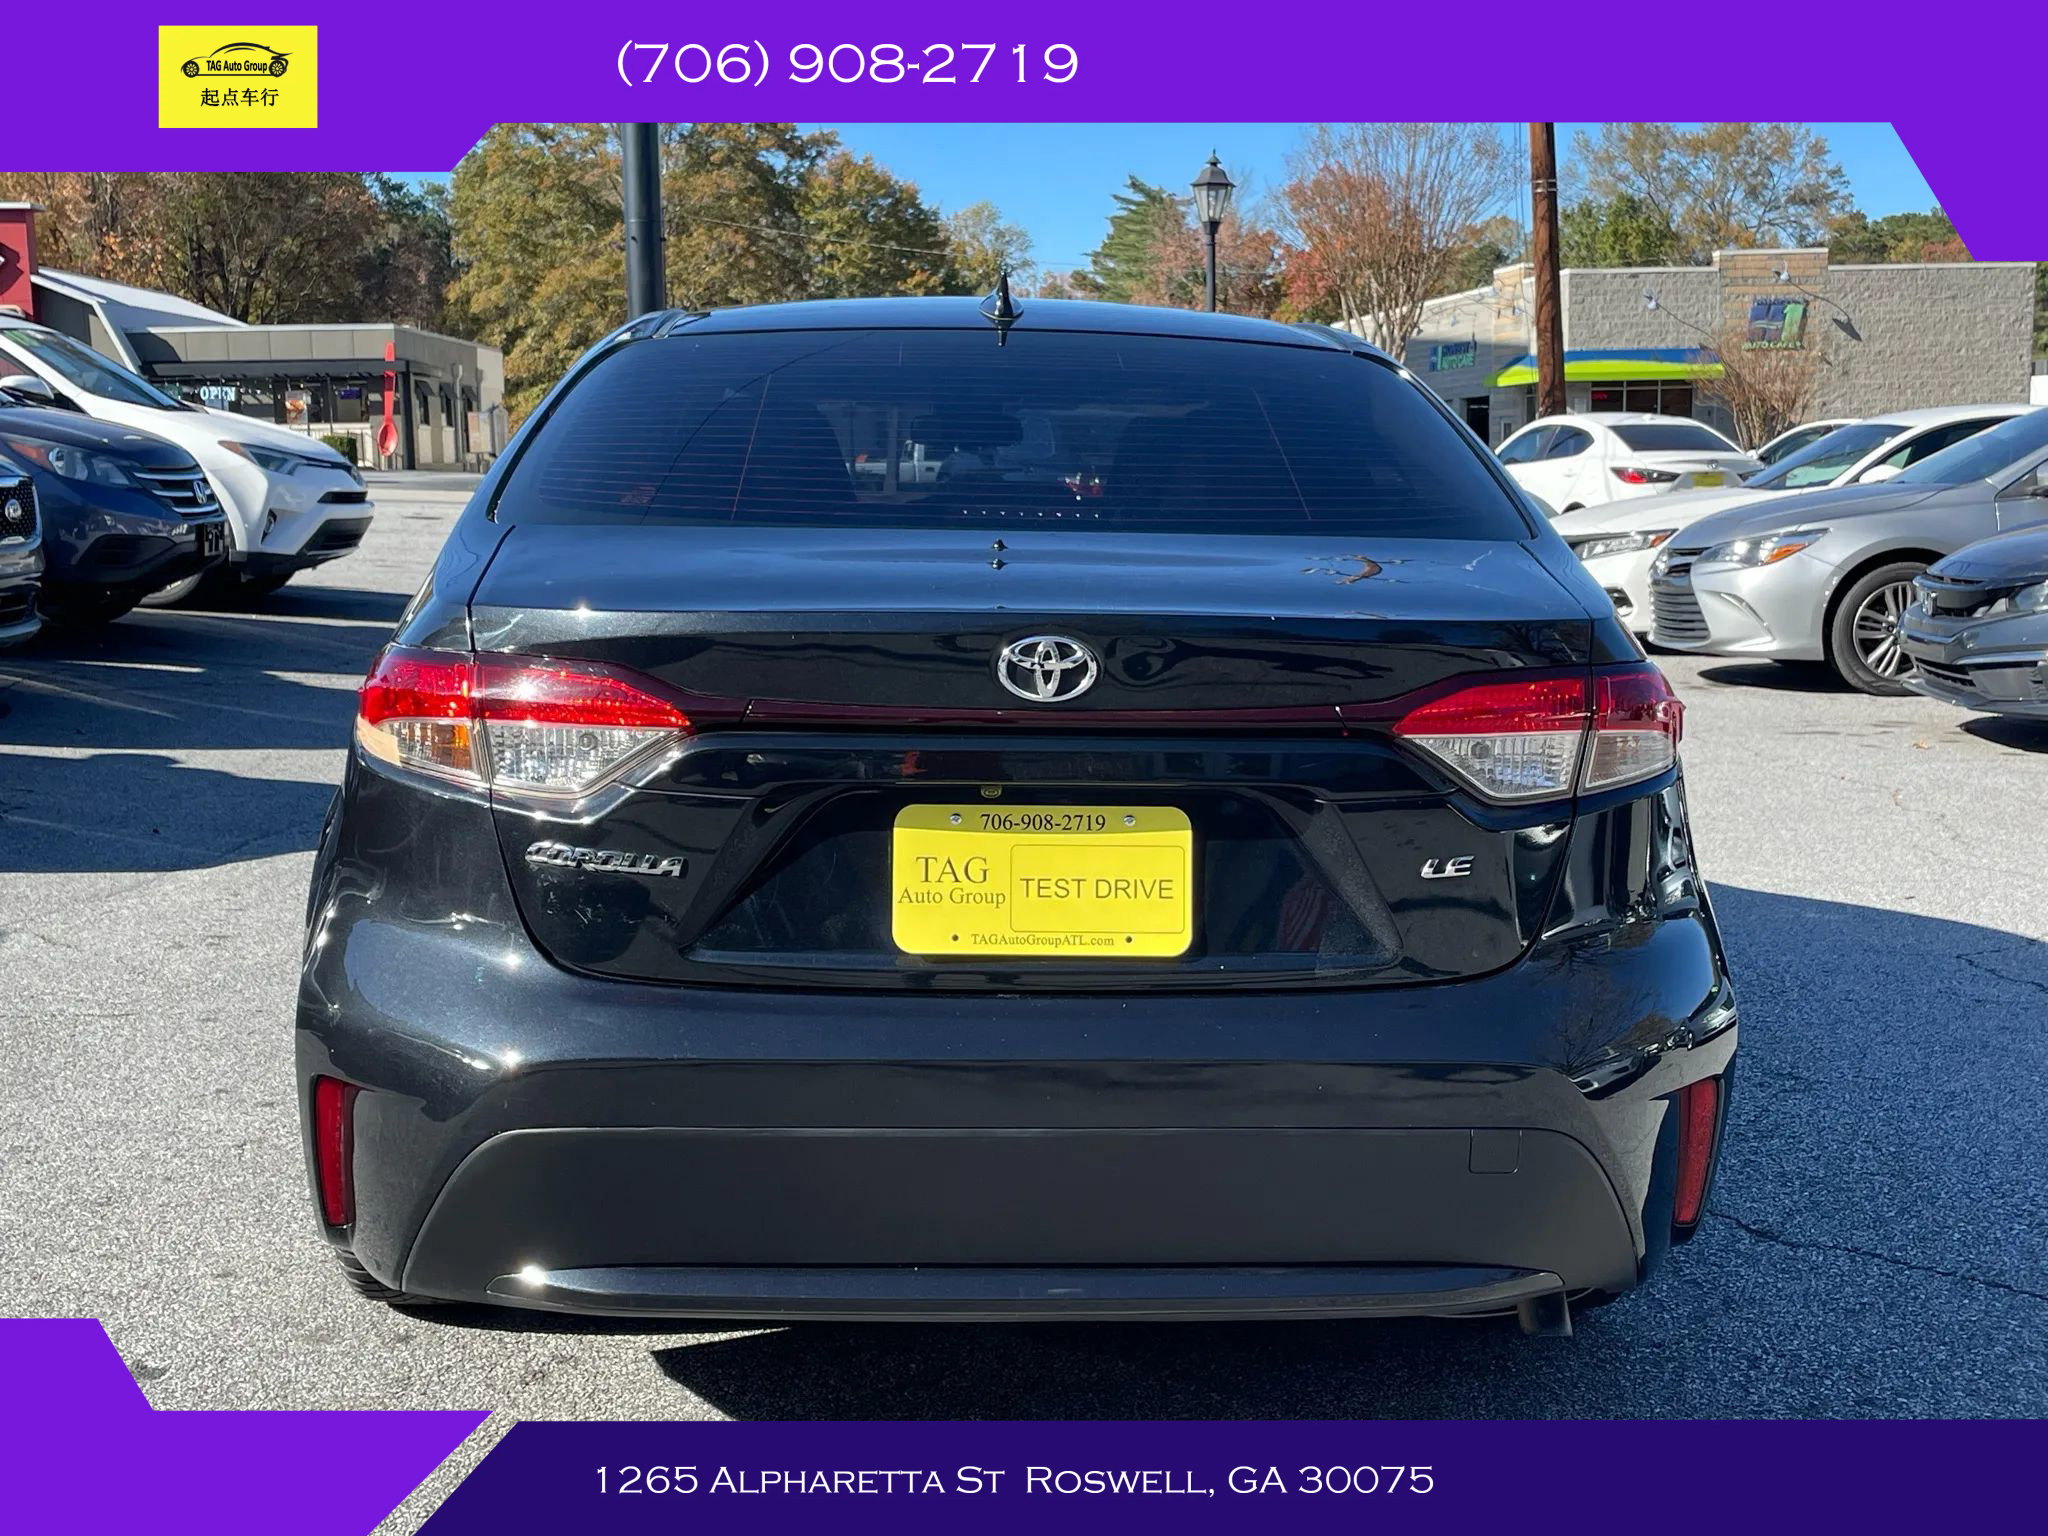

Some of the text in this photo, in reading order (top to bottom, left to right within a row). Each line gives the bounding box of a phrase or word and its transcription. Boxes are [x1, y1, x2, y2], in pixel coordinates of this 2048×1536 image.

[980, 813, 1106, 831] 706-908-2719
[525, 840, 687, 878] COROLLA
[1421, 855, 1475, 879] LE
[915, 856, 990, 885] TAG
[898, 887, 1006, 909] Auto Group
[1019, 878, 1174, 900] TEST DRIVE
[971, 934, 1115, 948] TAGAutoGroupATL.com
